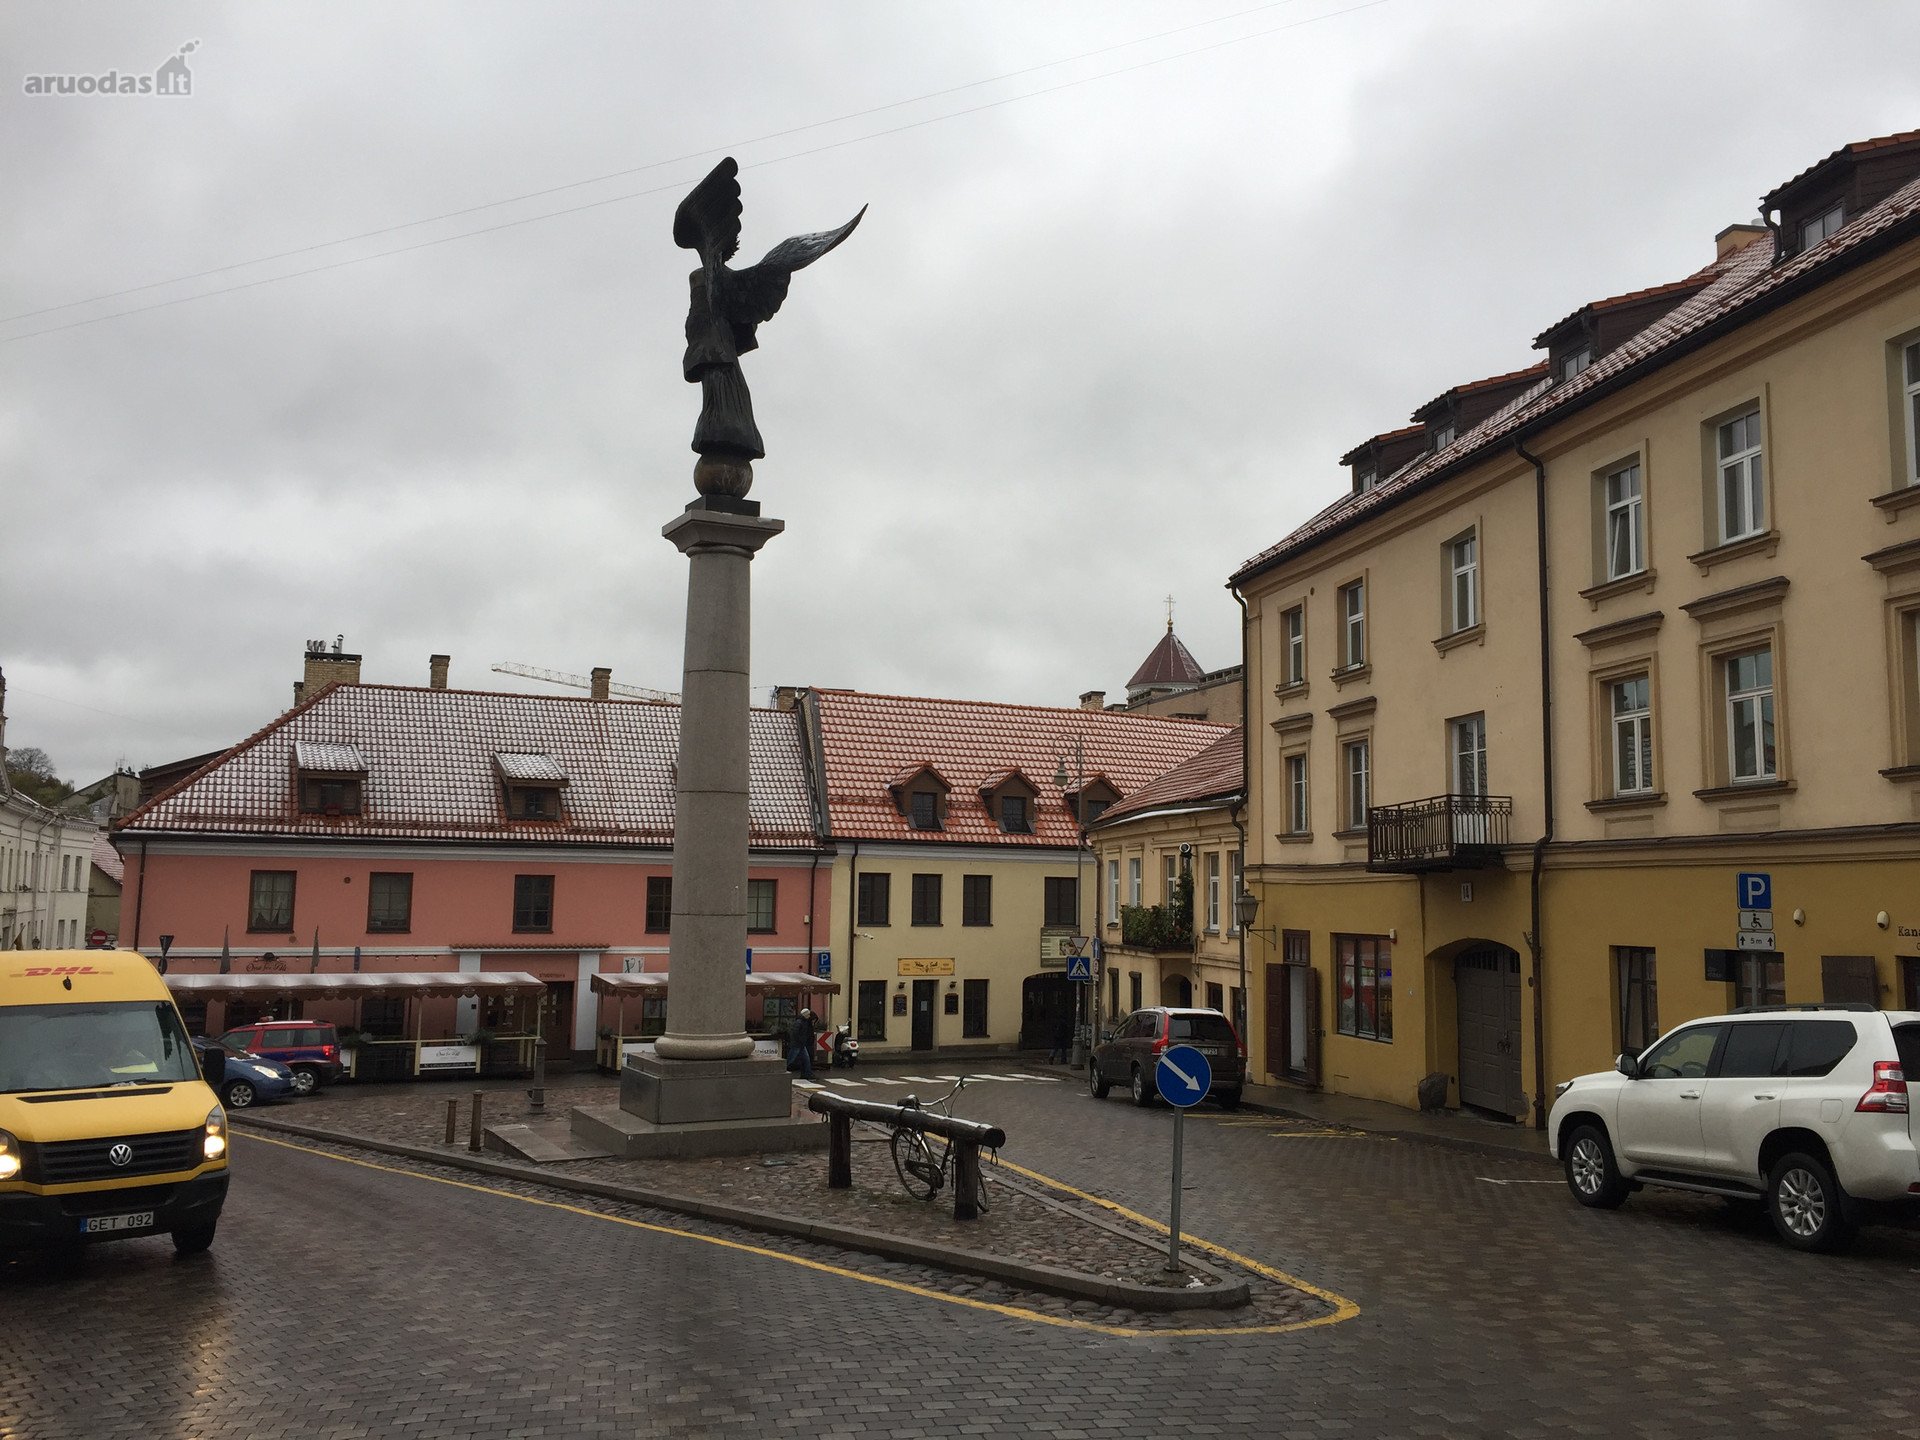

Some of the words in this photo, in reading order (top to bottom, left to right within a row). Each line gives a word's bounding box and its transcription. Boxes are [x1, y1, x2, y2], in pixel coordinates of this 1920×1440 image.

[1747, 877, 1766, 905] P
[1898, 925, 1920, 937] Kan
[821, 953, 829, 965] P
[24, 967, 99, 977] DHL
[89, 1218, 118, 1231] GET
[127, 1214, 151, 1227] 092
